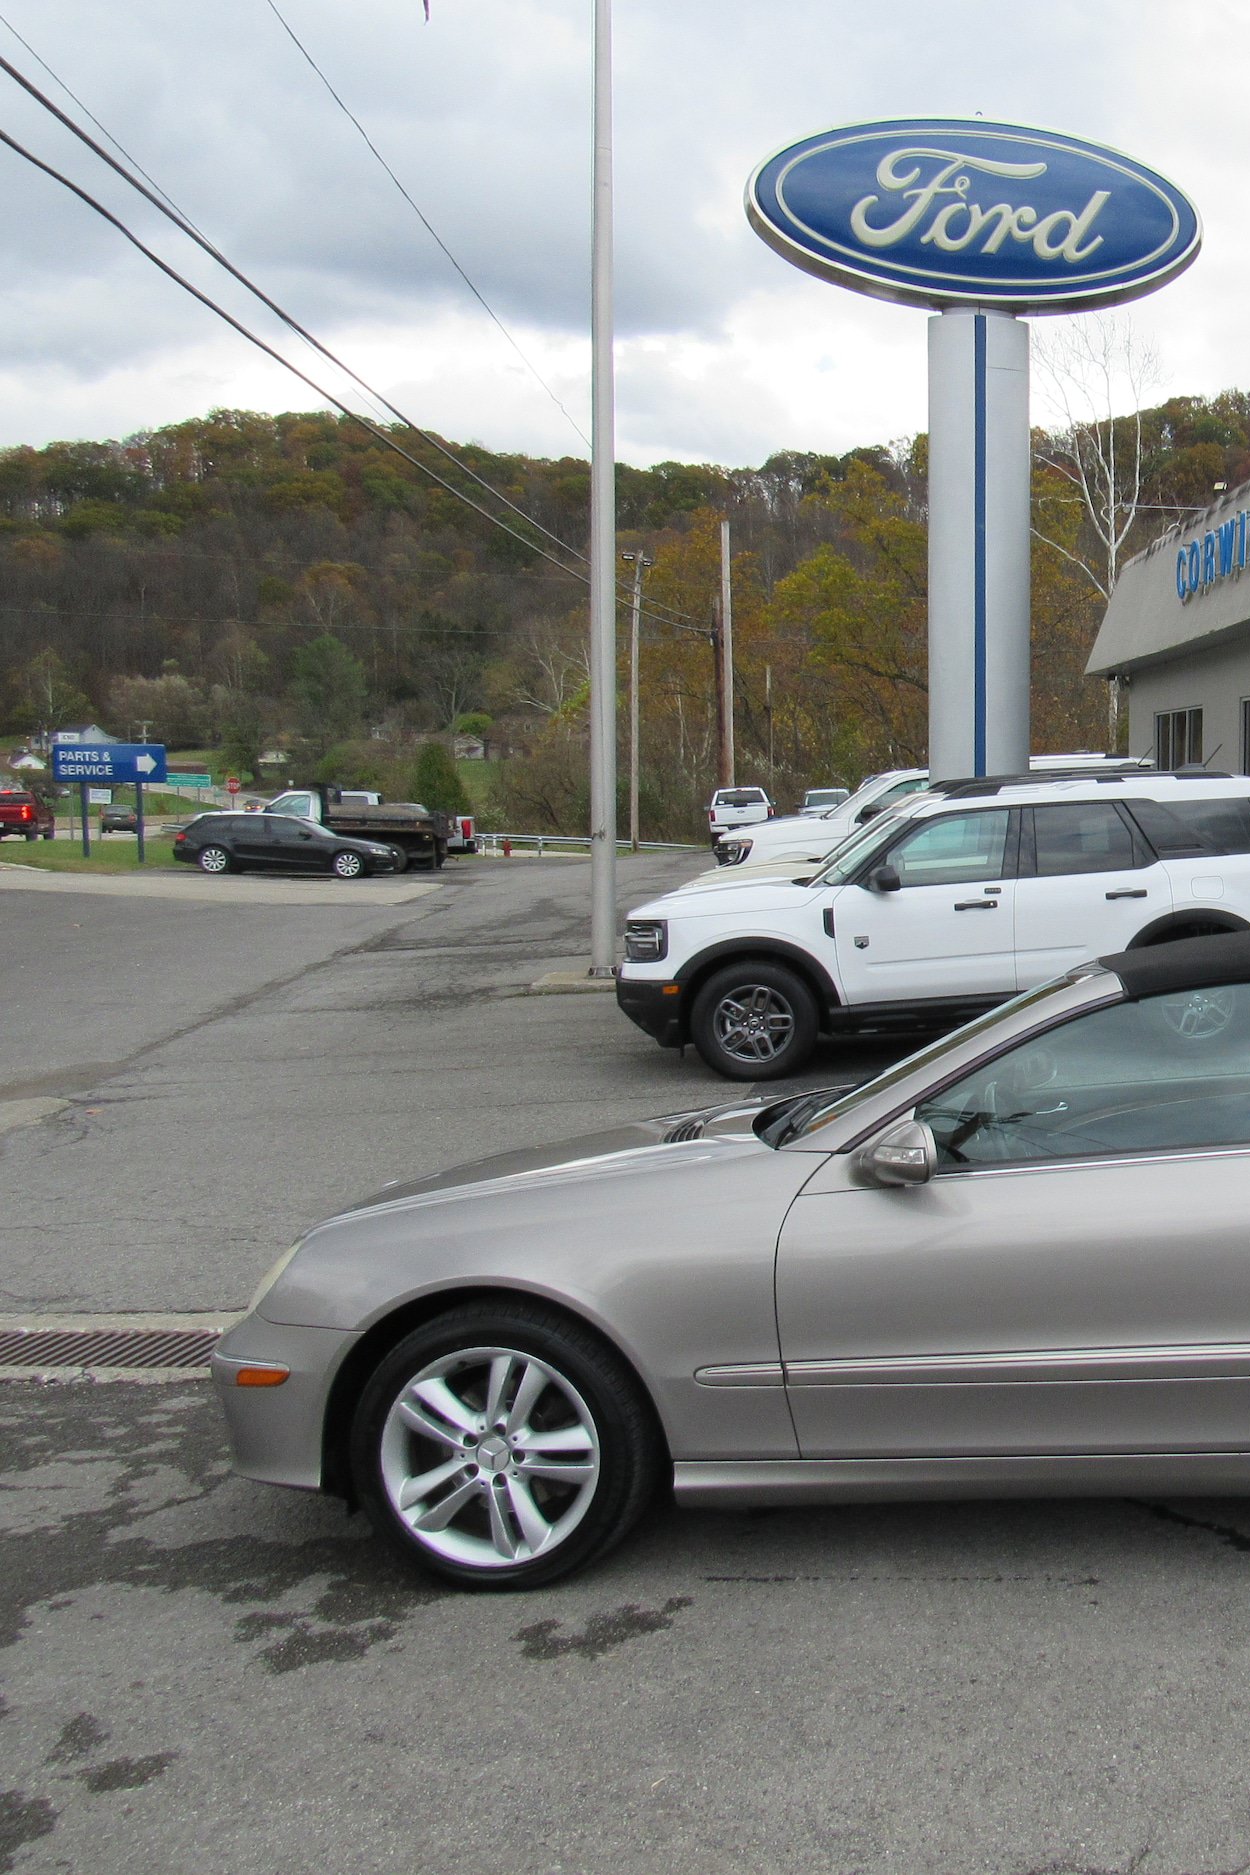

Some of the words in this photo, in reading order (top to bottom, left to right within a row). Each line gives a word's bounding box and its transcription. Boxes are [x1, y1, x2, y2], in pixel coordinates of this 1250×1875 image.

[850, 147, 1112, 263] Ford
[59, 751, 99, 762] PARTS
[102, 751, 111, 762] &
[59, 764, 114, 776] SERVICE
[226, 782, 240, 790] STOP
